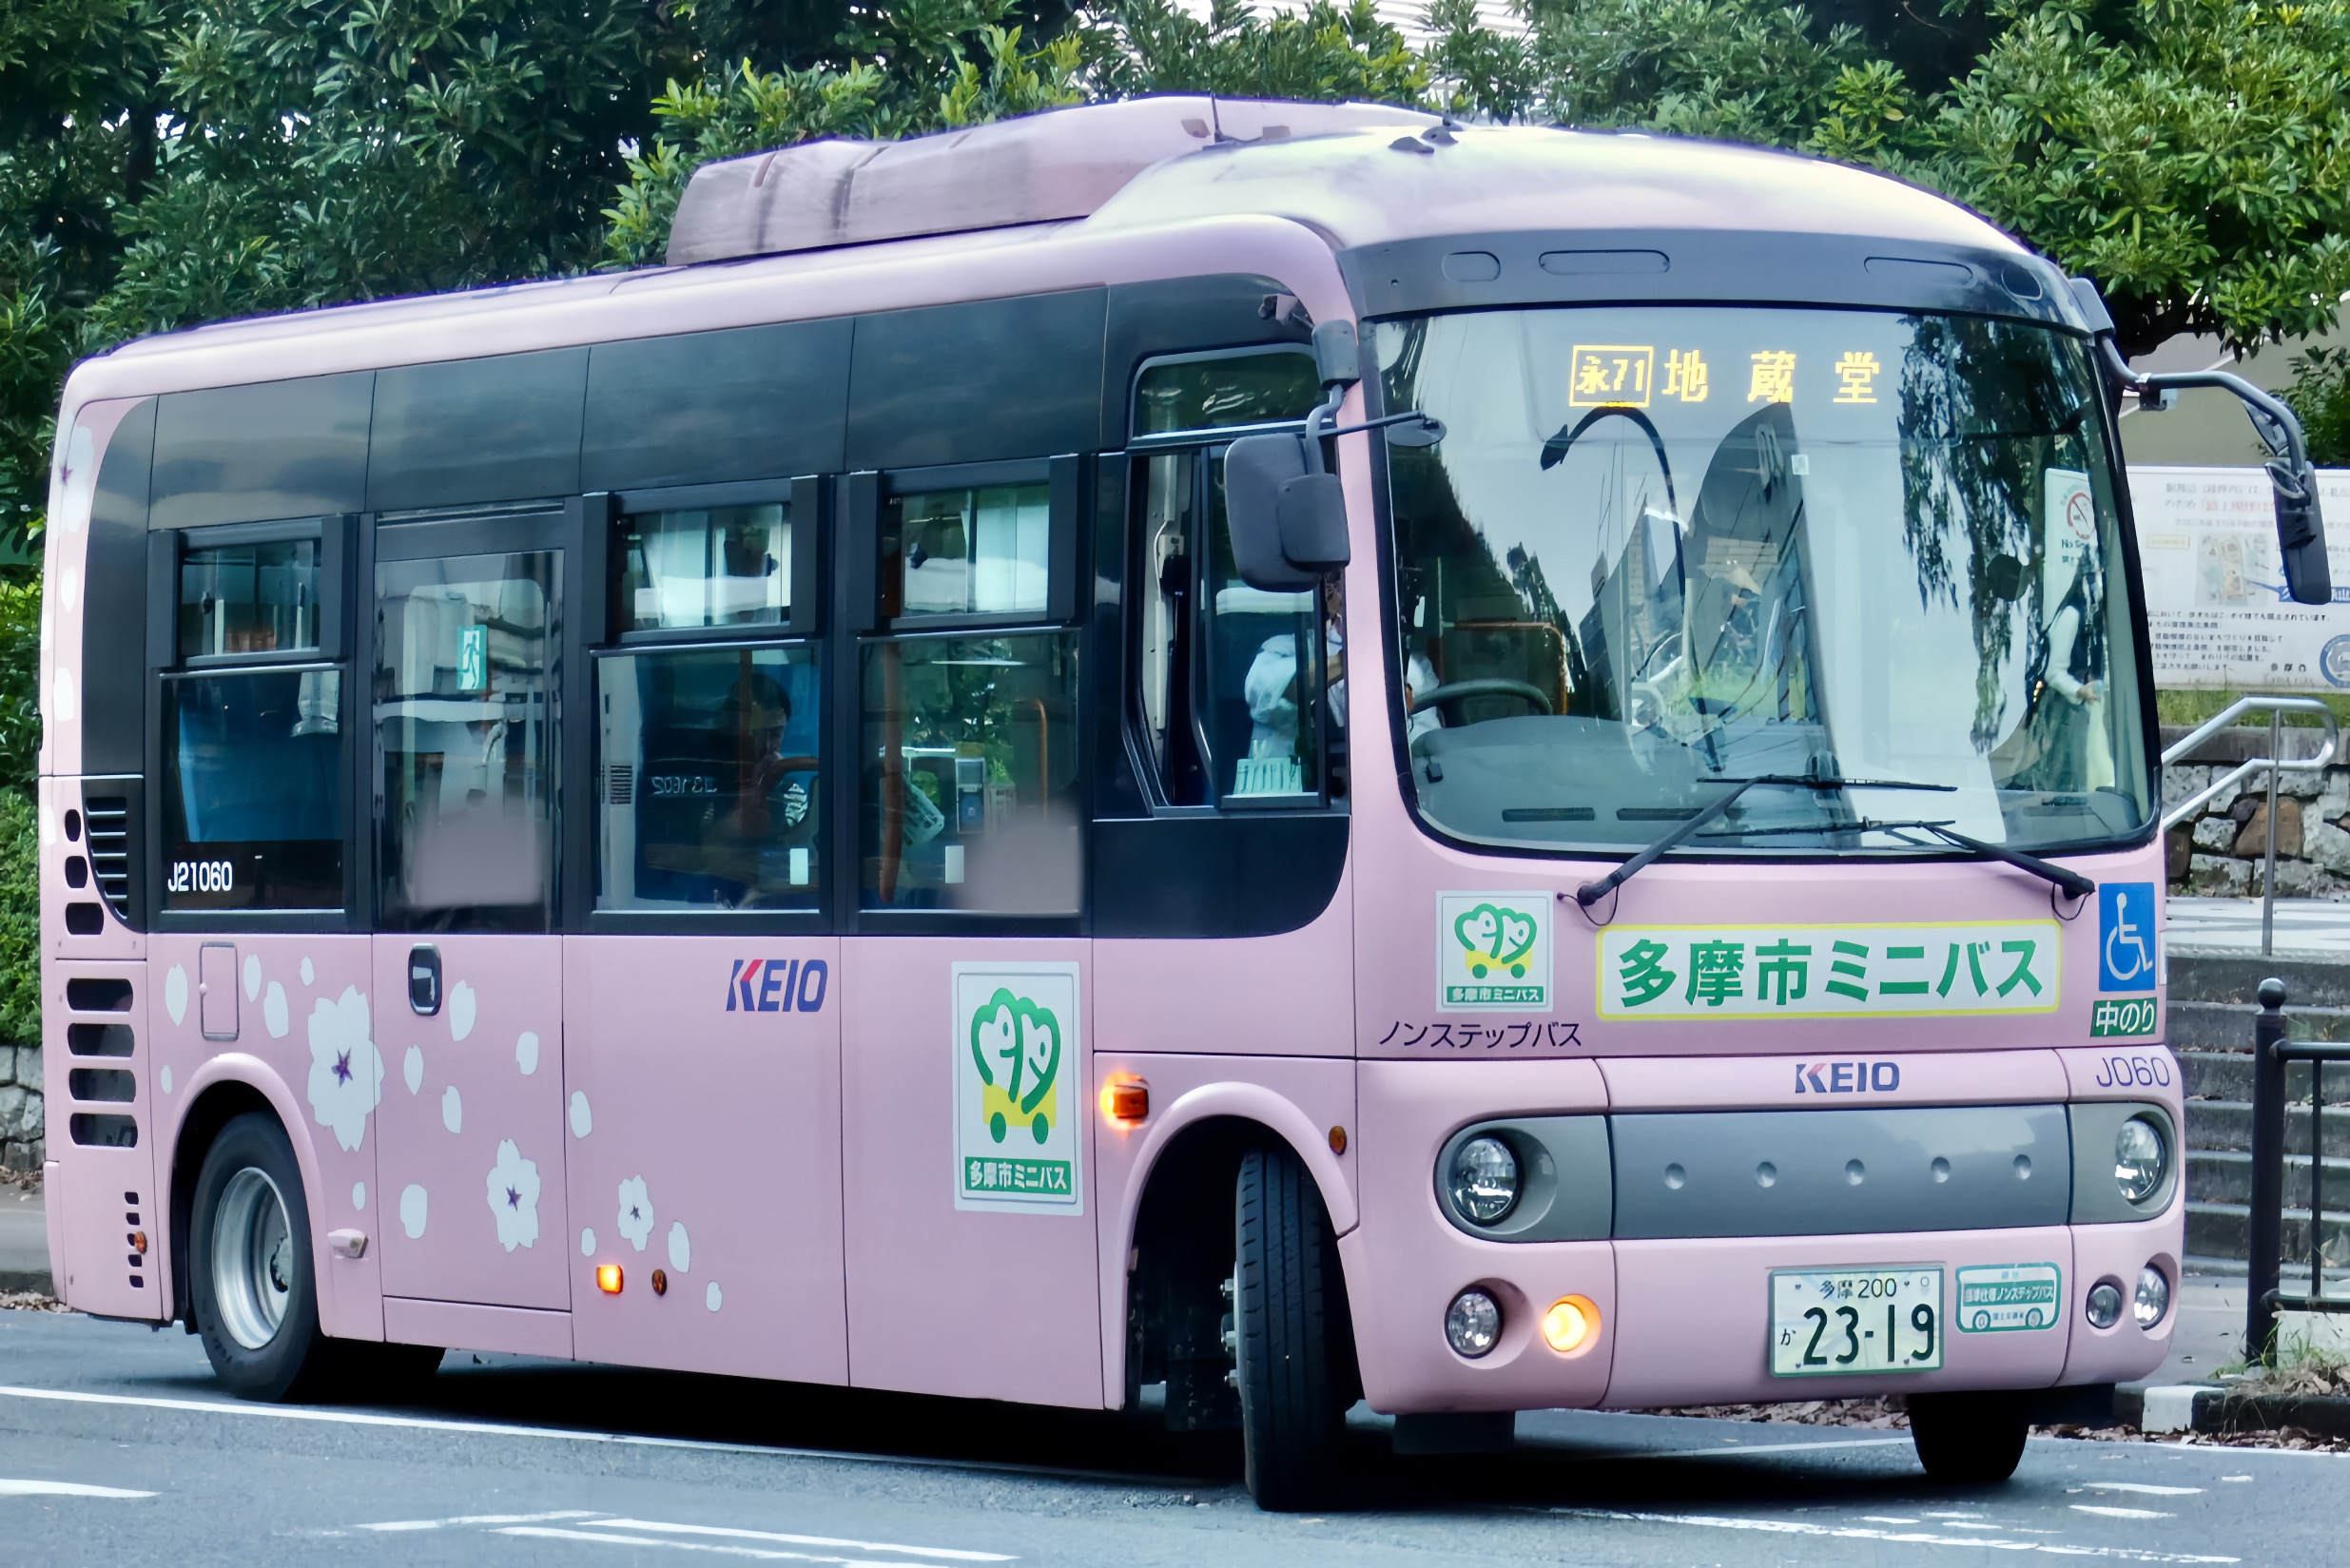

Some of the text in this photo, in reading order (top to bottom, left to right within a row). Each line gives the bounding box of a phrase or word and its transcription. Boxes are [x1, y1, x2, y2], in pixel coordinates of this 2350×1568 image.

[1574, 348, 1880, 404] 永71 地蔵堂
[167, 861, 233, 892] J21060
[726, 958, 828, 1013] KEIO
[1618, 938, 2044, 1008] 多摩市ミニバス
[1379, 1021, 1582, 1049] ノンステップバス
[2095, 1000, 2155, 1036] 中のり
[1794, 1060, 1901, 1094] KEIO
[969, 1159, 1067, 1191] 多摩市ミニバス
[1780, 1303, 1935, 1366] か 23-19
